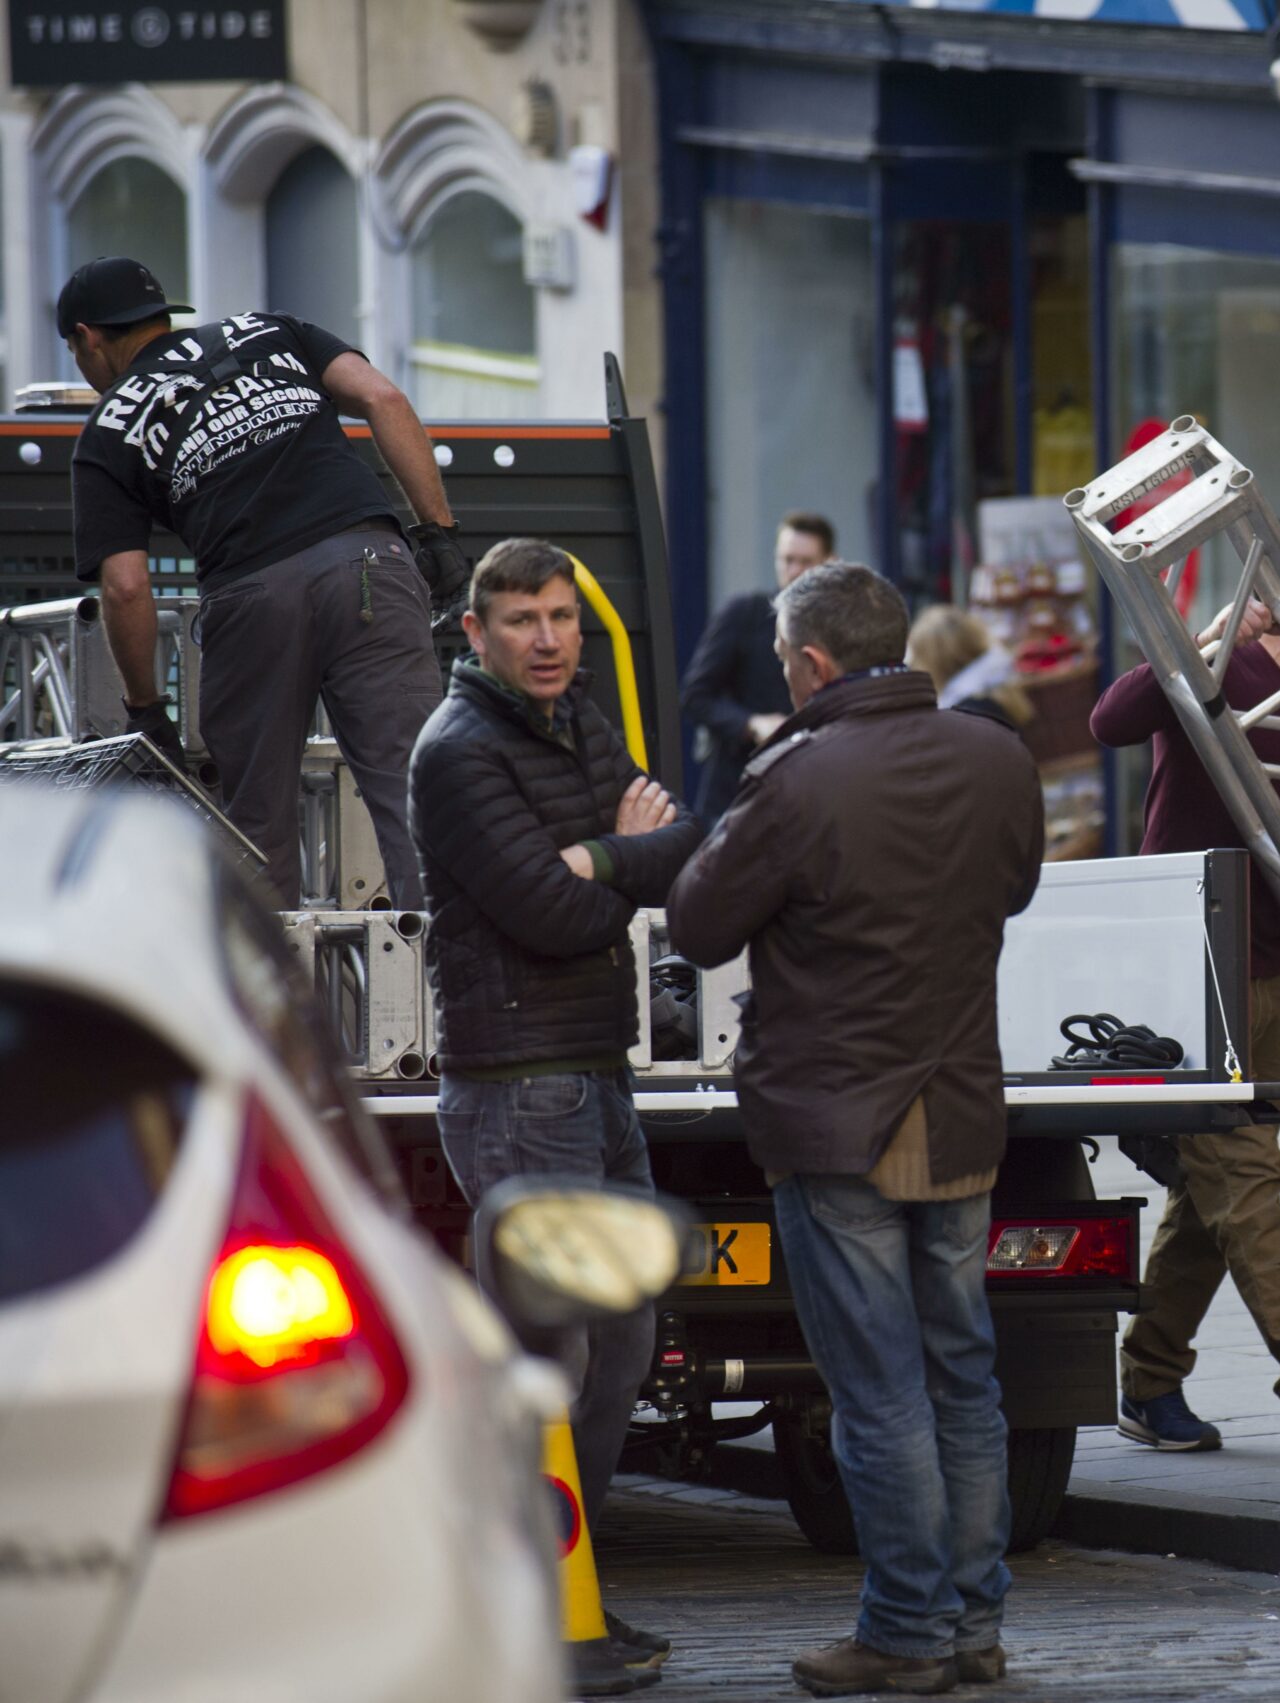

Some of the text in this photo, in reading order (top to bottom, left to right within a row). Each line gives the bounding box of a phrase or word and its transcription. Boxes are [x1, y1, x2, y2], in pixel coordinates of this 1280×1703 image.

[27, 13, 123, 44] TIME
[176, 10, 272, 40] TIDE
[207, 404, 250, 433] OUR
[248, 386, 321, 411] SECOND
[198, 438, 248, 476] Loaded
